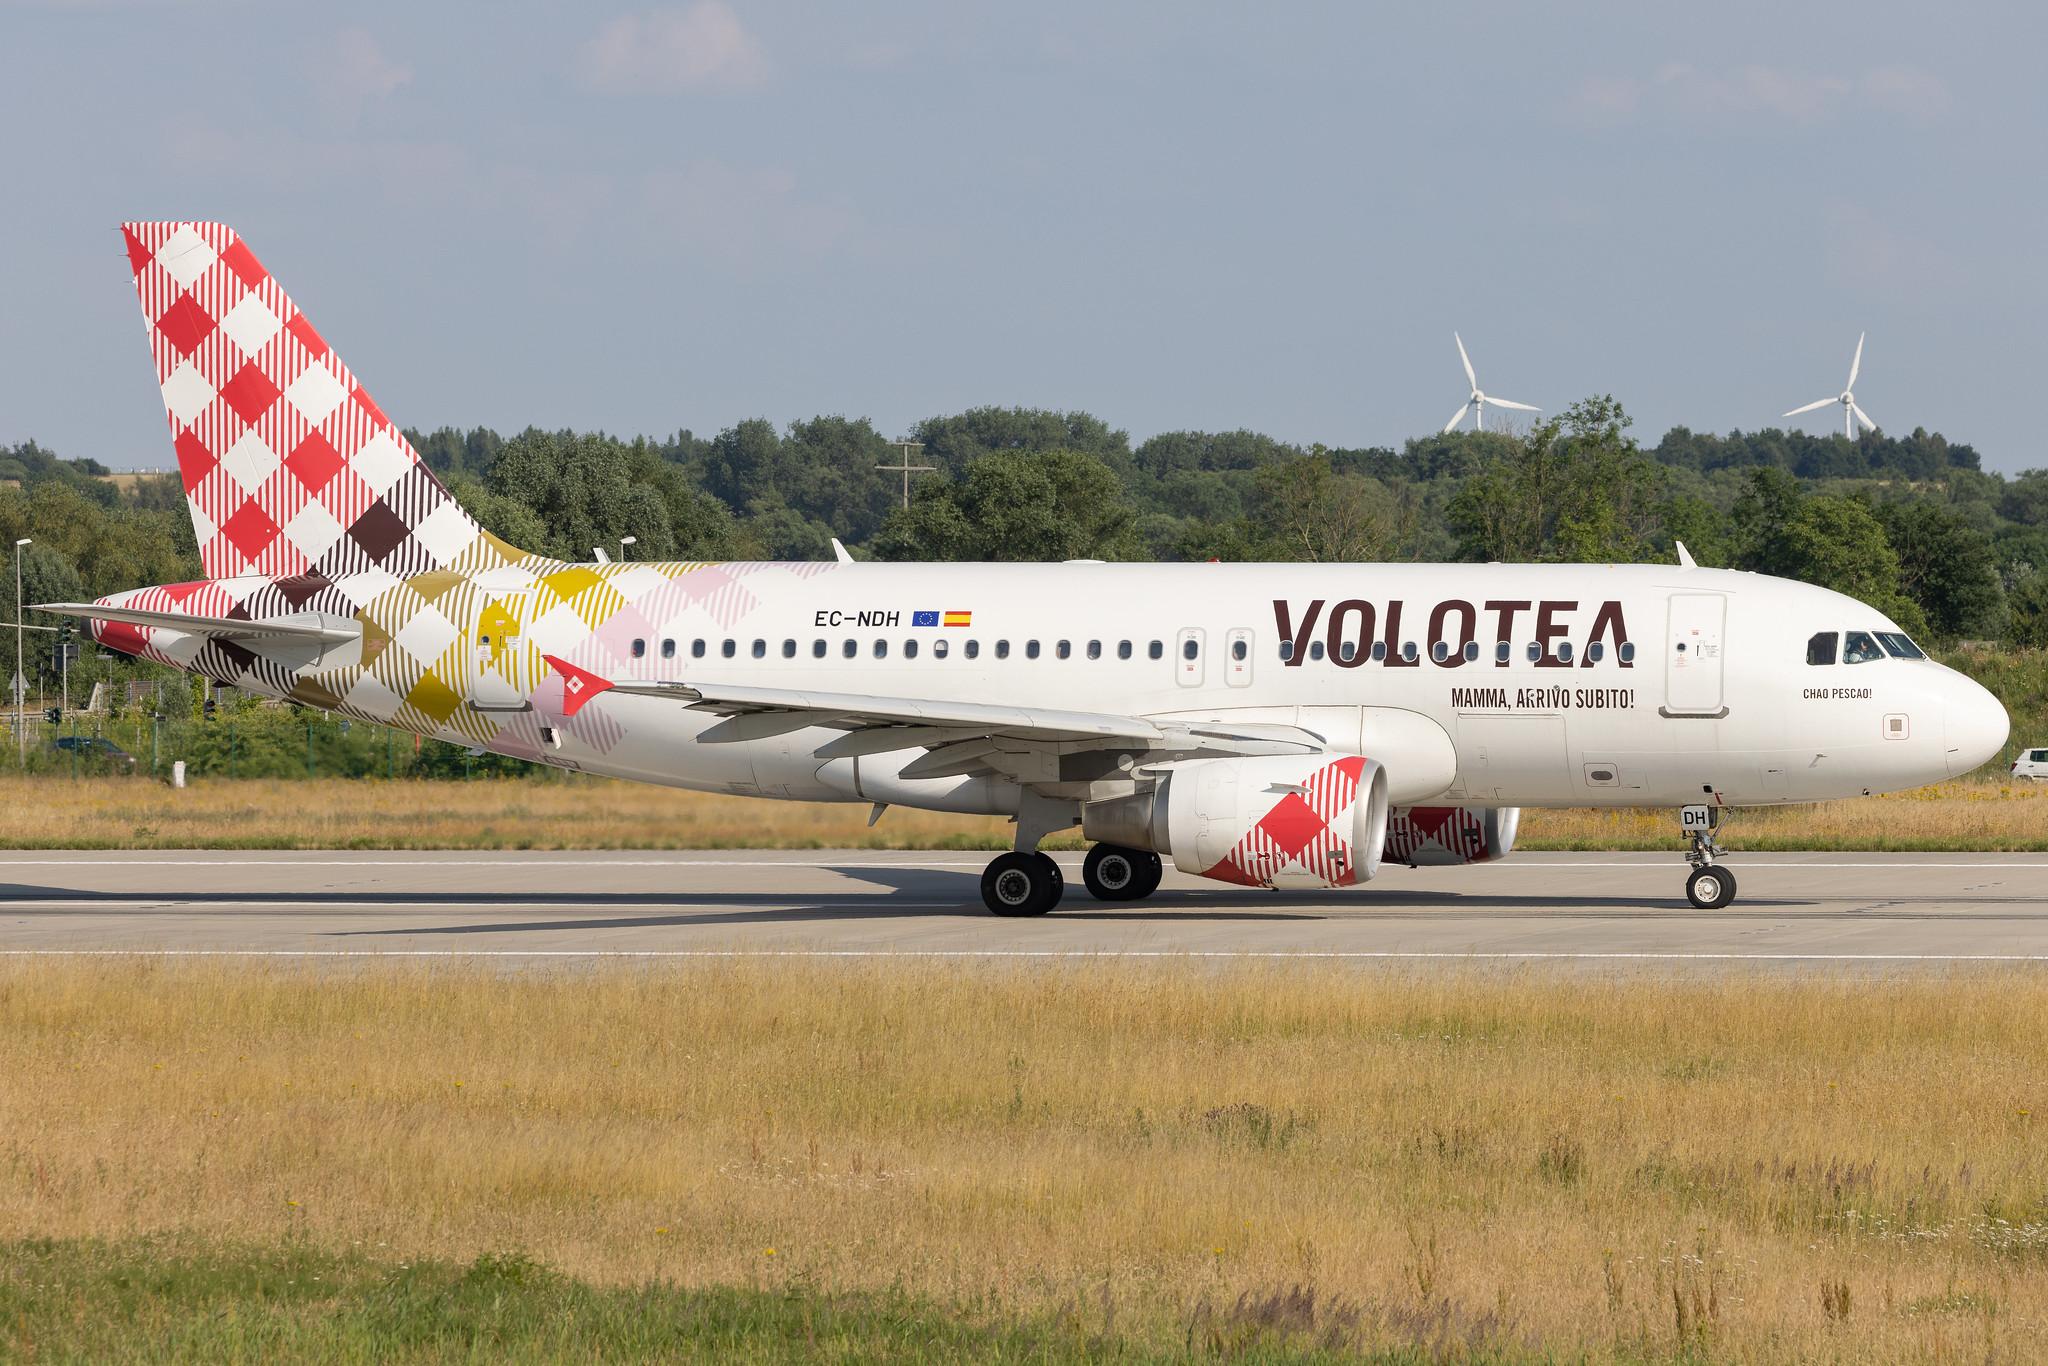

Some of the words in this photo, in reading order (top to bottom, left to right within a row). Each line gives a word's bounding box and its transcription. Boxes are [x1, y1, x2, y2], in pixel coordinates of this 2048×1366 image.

[814, 610, 900, 627] EC-NDH
[1272, 599, 1634, 669] VOLOTEA
[1451, 687, 1511, 711] MAMMA,
[1516, 687, 1570, 709] ARRIVO
[1575, 688, 1634, 709] SUBITO!
[1802, 688, 1829, 700] CHAO
[1832, 688, 1873, 700] PESCAO!
[1683, 811, 1706, 825] DH
